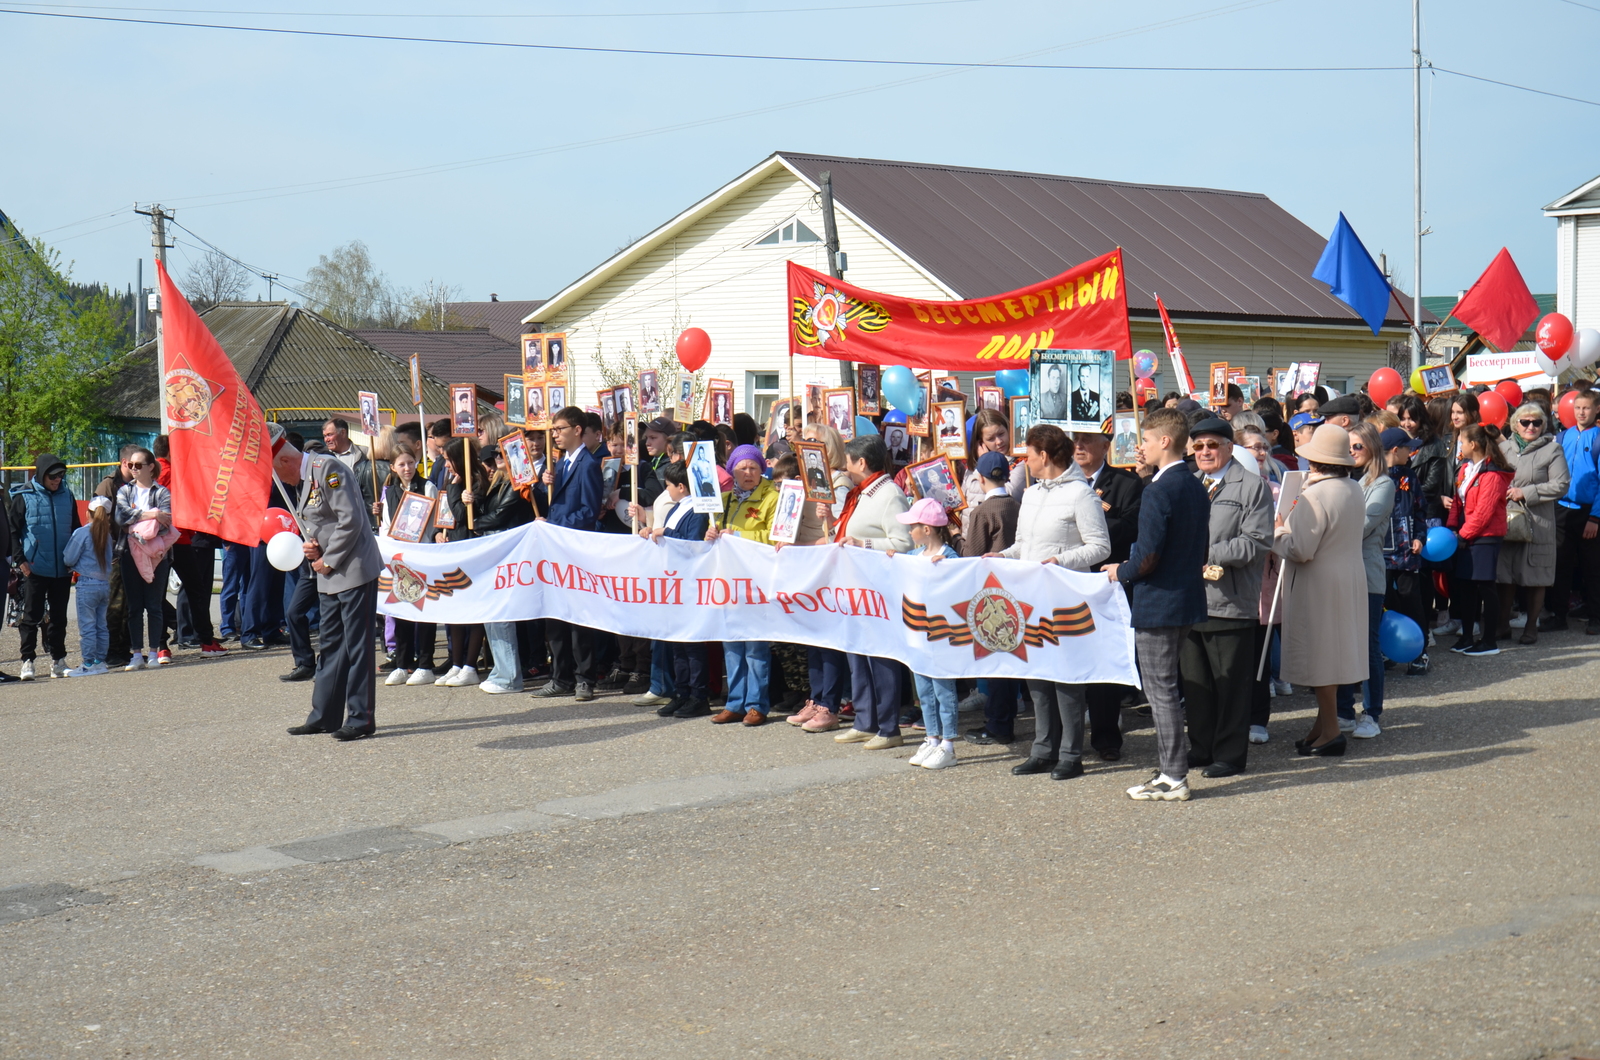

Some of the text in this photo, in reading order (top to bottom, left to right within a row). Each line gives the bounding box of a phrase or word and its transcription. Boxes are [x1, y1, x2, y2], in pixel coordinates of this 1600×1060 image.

[908, 257, 1119, 324] БЕССМЕРТНЫЙ
[1041, 353, 1082, 361] БЕССМЕРТНЫЙ
[1469, 355, 1530, 369] Бессмертный
[494, 559, 684, 605] БЕССМЕРТНЫЙ
[776, 586, 891, 621] РОССИИ
